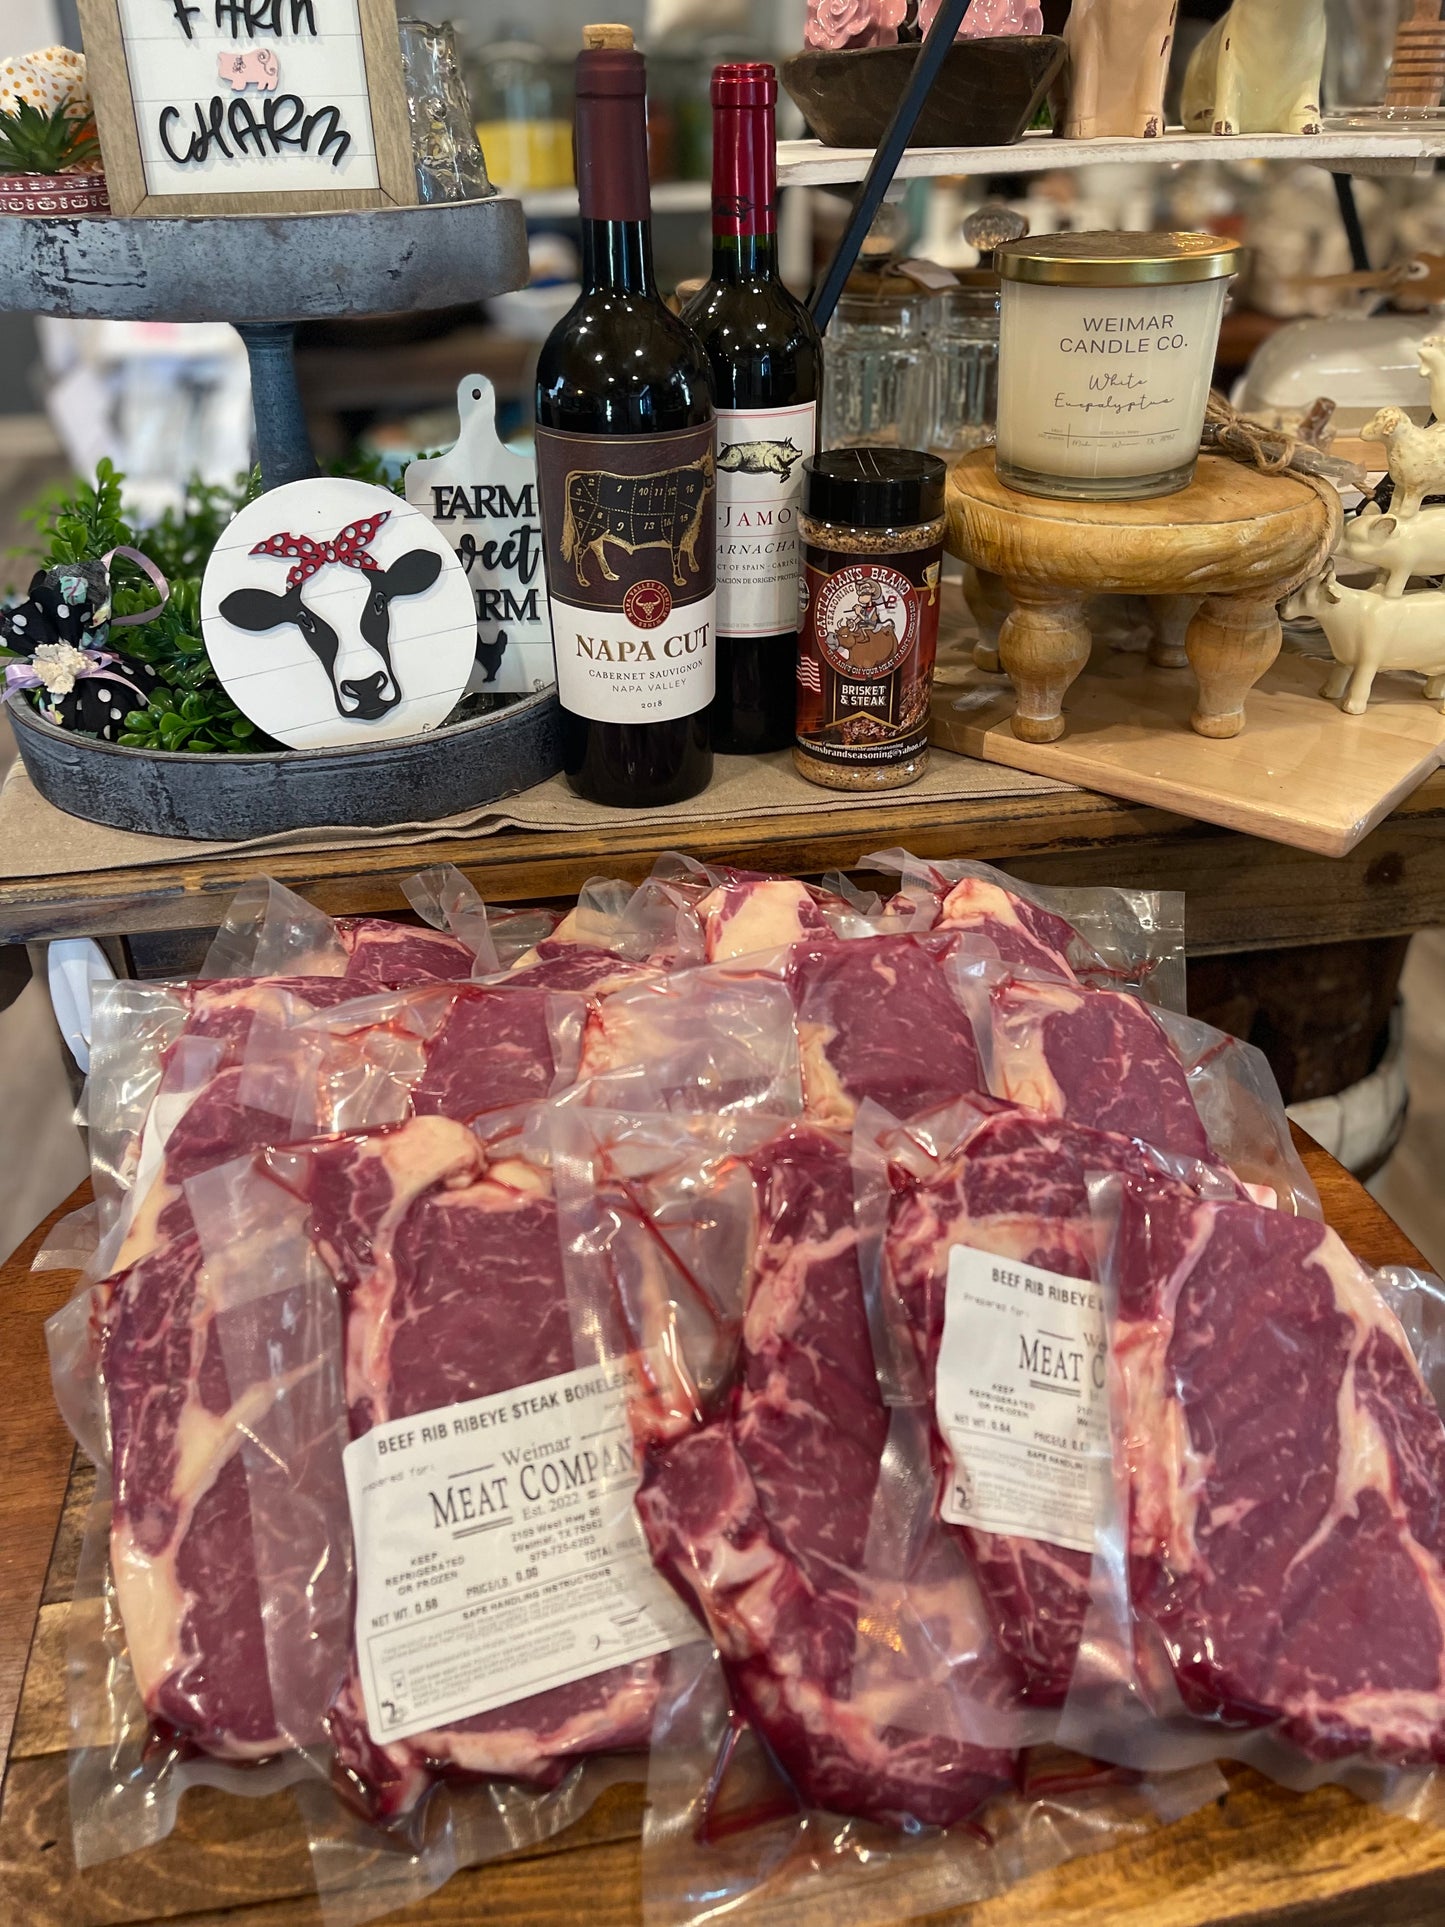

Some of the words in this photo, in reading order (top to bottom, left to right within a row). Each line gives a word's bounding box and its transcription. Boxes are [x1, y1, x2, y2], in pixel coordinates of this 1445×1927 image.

[159, 94, 351, 166] CHARM
[1083, 314, 1174, 332] WEIMAR
[1060, 338, 1150, 354] CANDLE
[1157, 334, 1188, 351] CO.
[1089, 372, 1148, 391] White
[431, 484, 536, 519] FARM
[724, 506, 799, 528] JAMO
[716, 540, 795, 555] ARNACHA
[476, 589, 540, 621] RM
[816, 567, 863, 638] CATTLEMAN'S
[870, 567, 911, 596] BRAND
[827, 584, 856, 626] SEASONING
[576, 634, 656, 662] NAPA
[664, 622, 710, 658] CUT
[588, 669, 646, 681] CABERNET
[650, 658, 703, 680] SAUVIGNON
[612, 685, 643, 693] NAPA
[647, 678, 687, 692] VALLEY
[842, 684, 886, 696] BRISKET
[641, 700, 663, 709] 2018
[840, 696, 849, 705] &
[850, 696, 886, 706] STEAK
[992, 1268, 1021, 1288] BEEF
[1024, 1278, 1045, 1296] RIB
[1048, 1286, 1096, 1309] RIBEYE
[1019, 1334, 1084, 1383] MEAT
[378, 1431, 415, 1456] BEEF
[421, 1424, 448, 1443] RIB
[453, 1408, 508, 1436] RIBEYE
[511, 1393, 561, 1419] STEAK
[502, 1435, 572, 1467] Weimar
[428, 1477, 509, 1530] MEAT
[519, 1440, 637, 1501] COMPAN
[550, 1491, 579, 1513] 2022
[536, 1517, 562, 1534] West
[411, 1551, 438, 1566] KEEP
[385, 1554, 465, 1587] REFRIGERATED
[515, 1566, 539, 1583] 0.00
[397, 1584, 413, 1597] OR
[416, 1570, 459, 1590] FROZEN
[463, 1605, 488, 1620] SAFE
[491, 1590, 540, 1611] HANDLING
[542, 1568, 612, 1595] INSTRUCTIONS
[371, 1613, 390, 1629] NET
